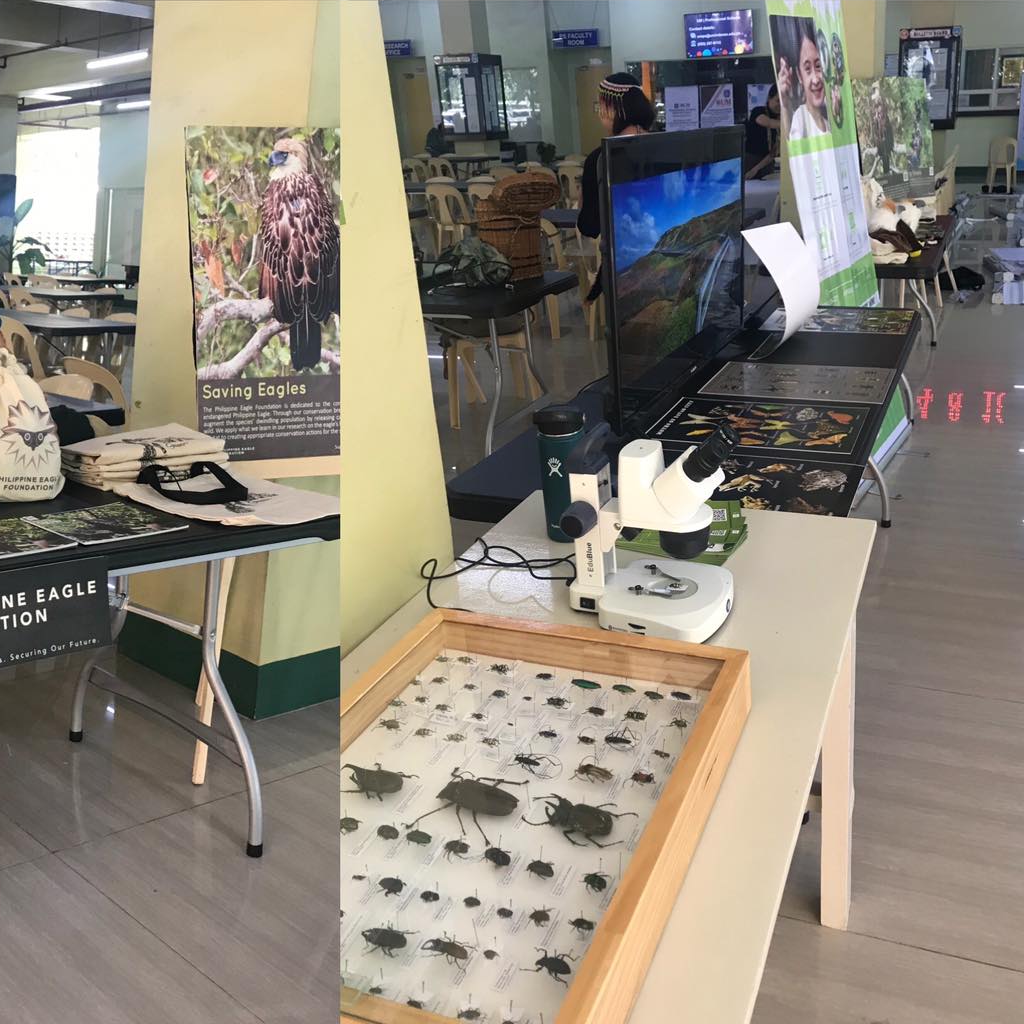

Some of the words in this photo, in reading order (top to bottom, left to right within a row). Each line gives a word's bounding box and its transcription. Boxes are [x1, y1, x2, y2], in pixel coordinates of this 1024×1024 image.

[203, 384, 252, 400] Saving
[258, 381, 306, 399] Eagles
[203, 413, 232, 421] endangered
[36, 580, 97, 603] EAGLE
[10, 648, 47, 661] Securing
[51, 643, 66, 653] Our
[69, 637, 100, 649] Future.
